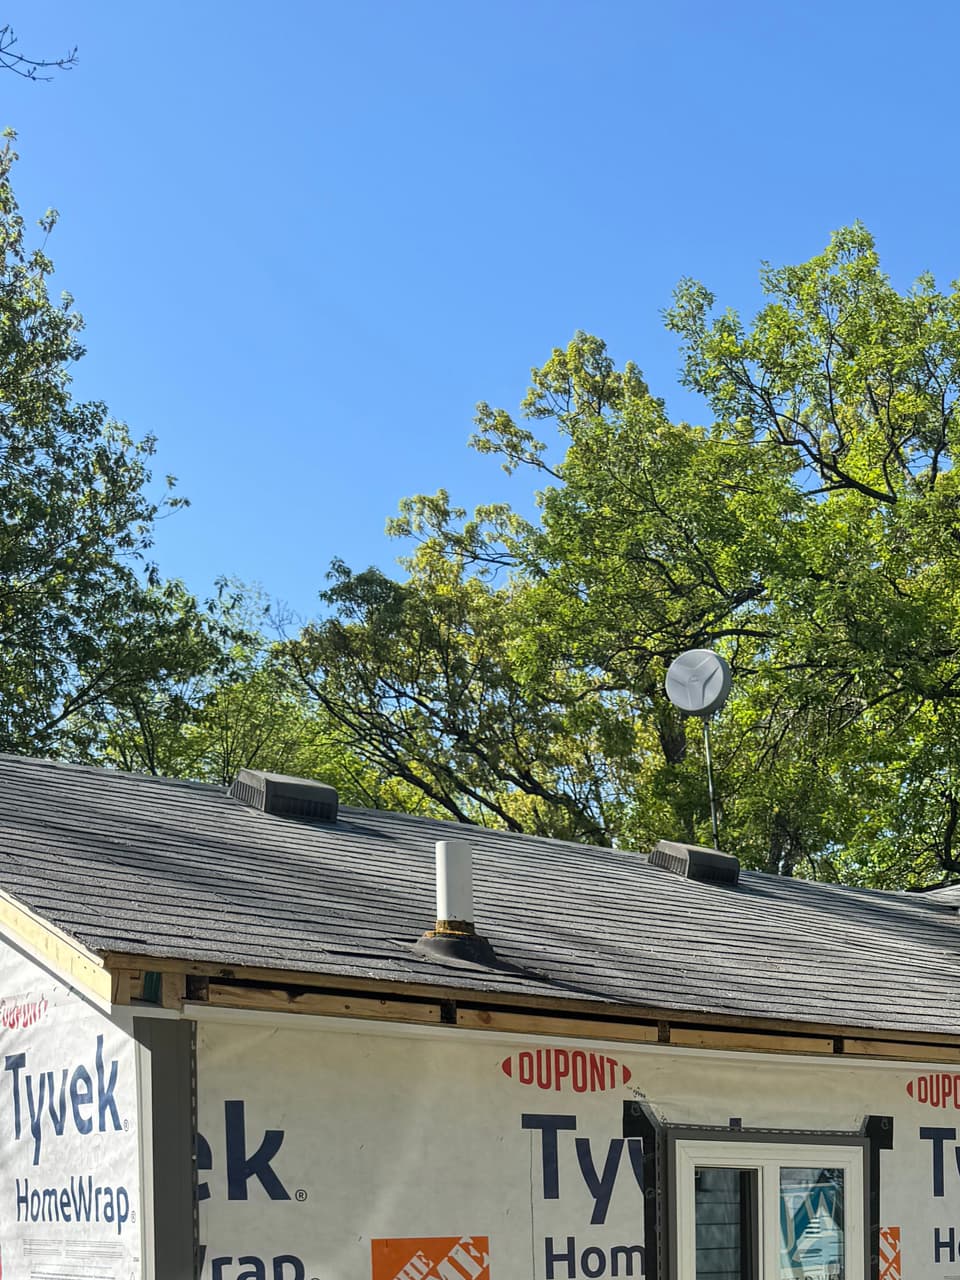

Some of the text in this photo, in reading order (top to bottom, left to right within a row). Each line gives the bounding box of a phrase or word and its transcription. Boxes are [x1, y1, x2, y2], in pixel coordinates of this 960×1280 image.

[5, 1034, 123, 1166] Tyvek
[519, 1048, 618, 1093] DUPONT
[16, 1176, 129, 1235] HomeWrap
